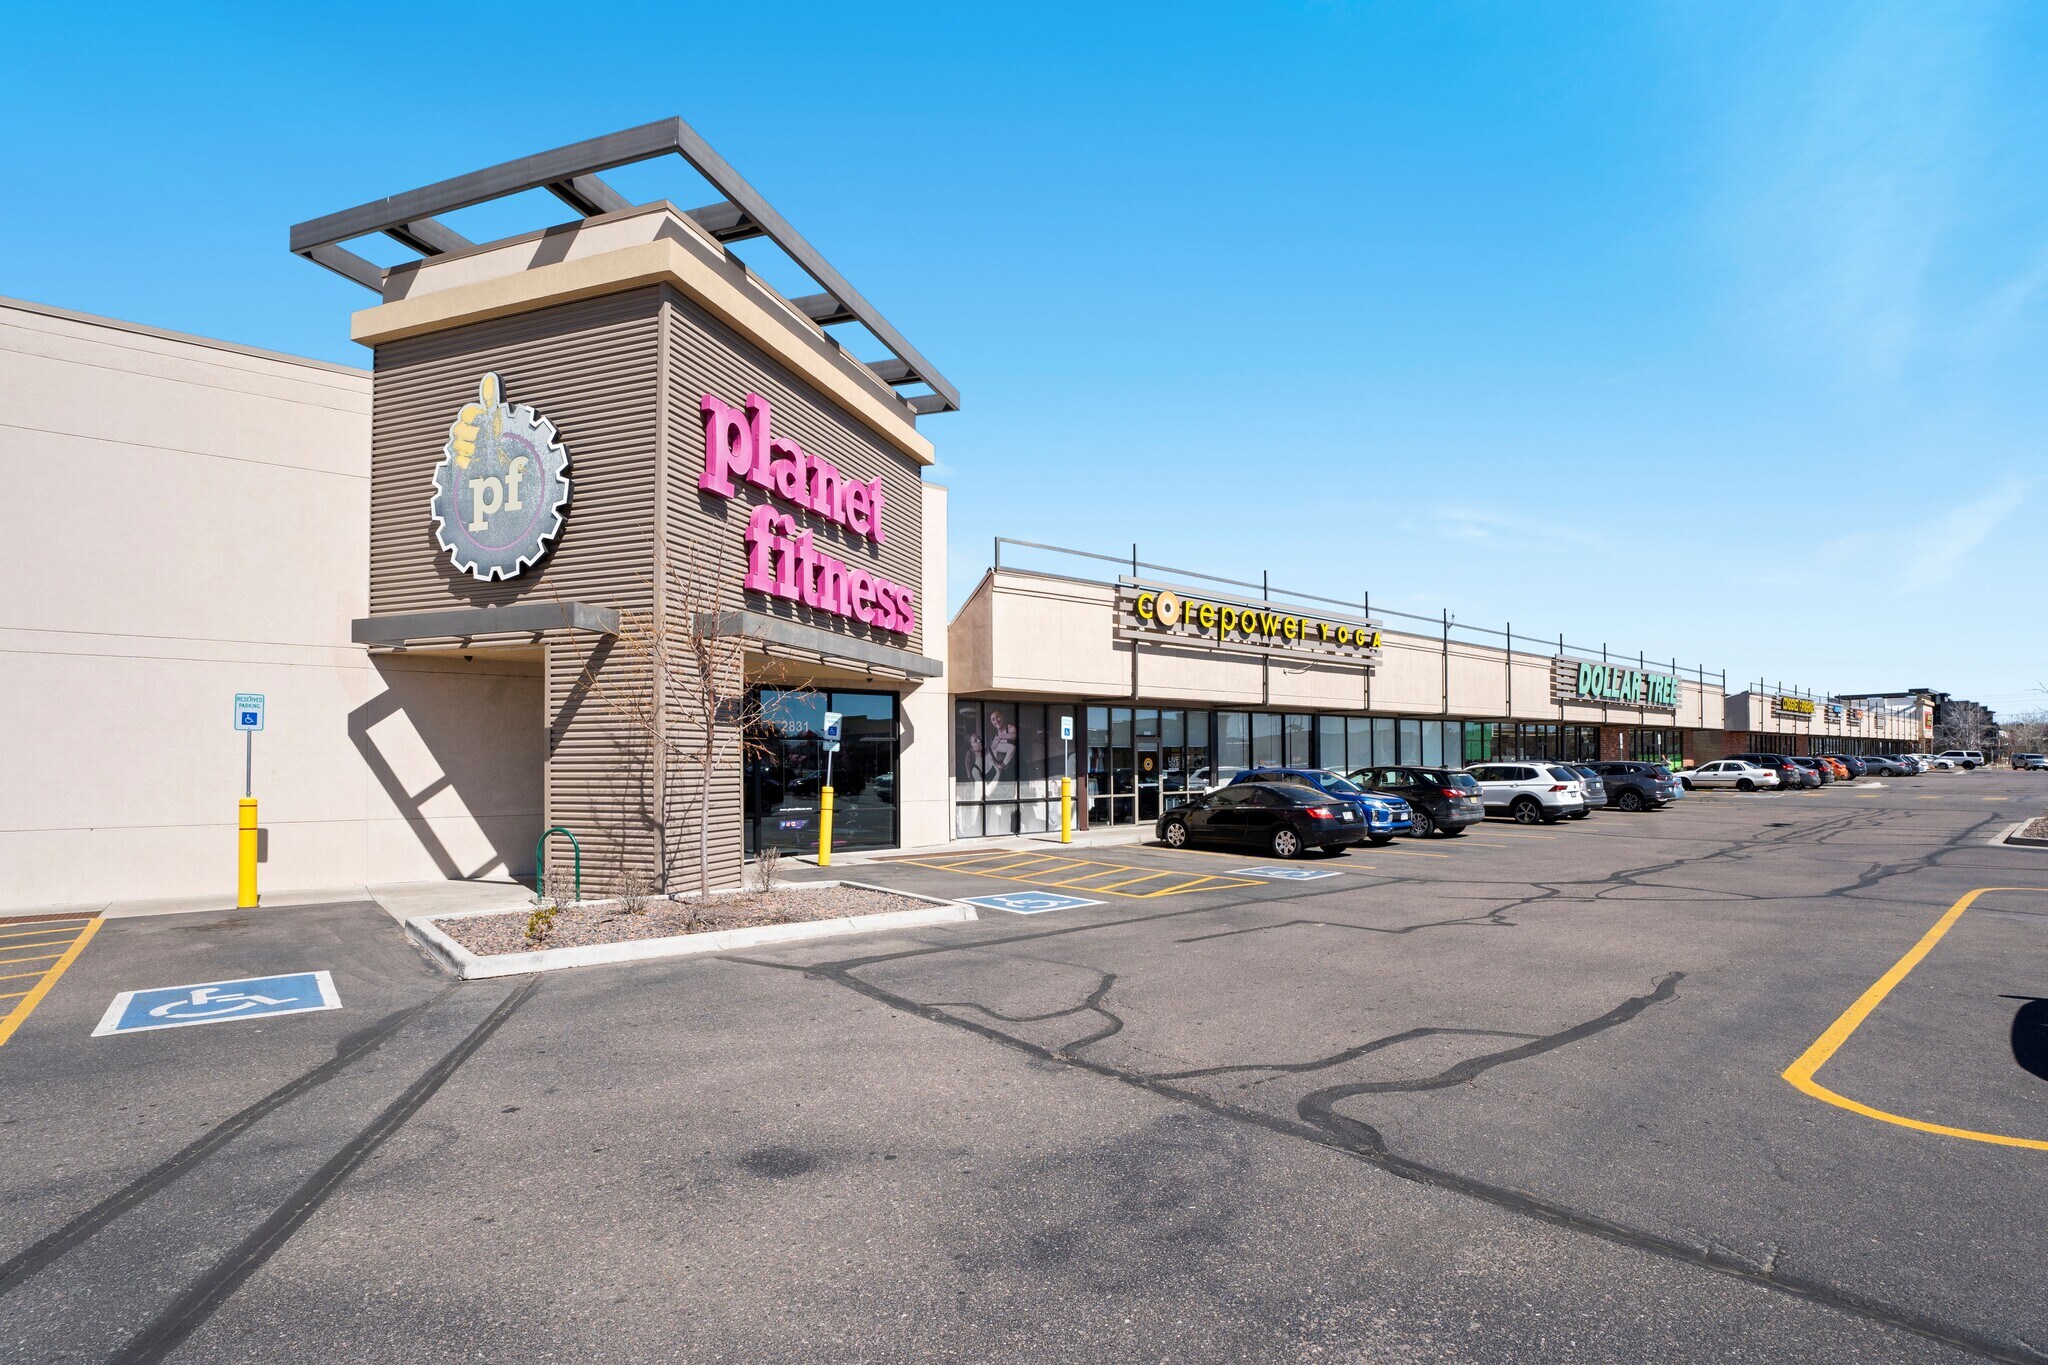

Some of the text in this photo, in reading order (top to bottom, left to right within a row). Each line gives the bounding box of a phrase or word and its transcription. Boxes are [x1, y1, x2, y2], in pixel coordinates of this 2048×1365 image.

[468, 456, 529, 532] pf
[699, 392, 886, 544] planet
[744, 504, 915, 634] fitness
[1316, 623, 1382, 648] YOGA
[1577, 662, 1679, 705] DOLLAR TREE
[781, 720, 809, 733] 2831
